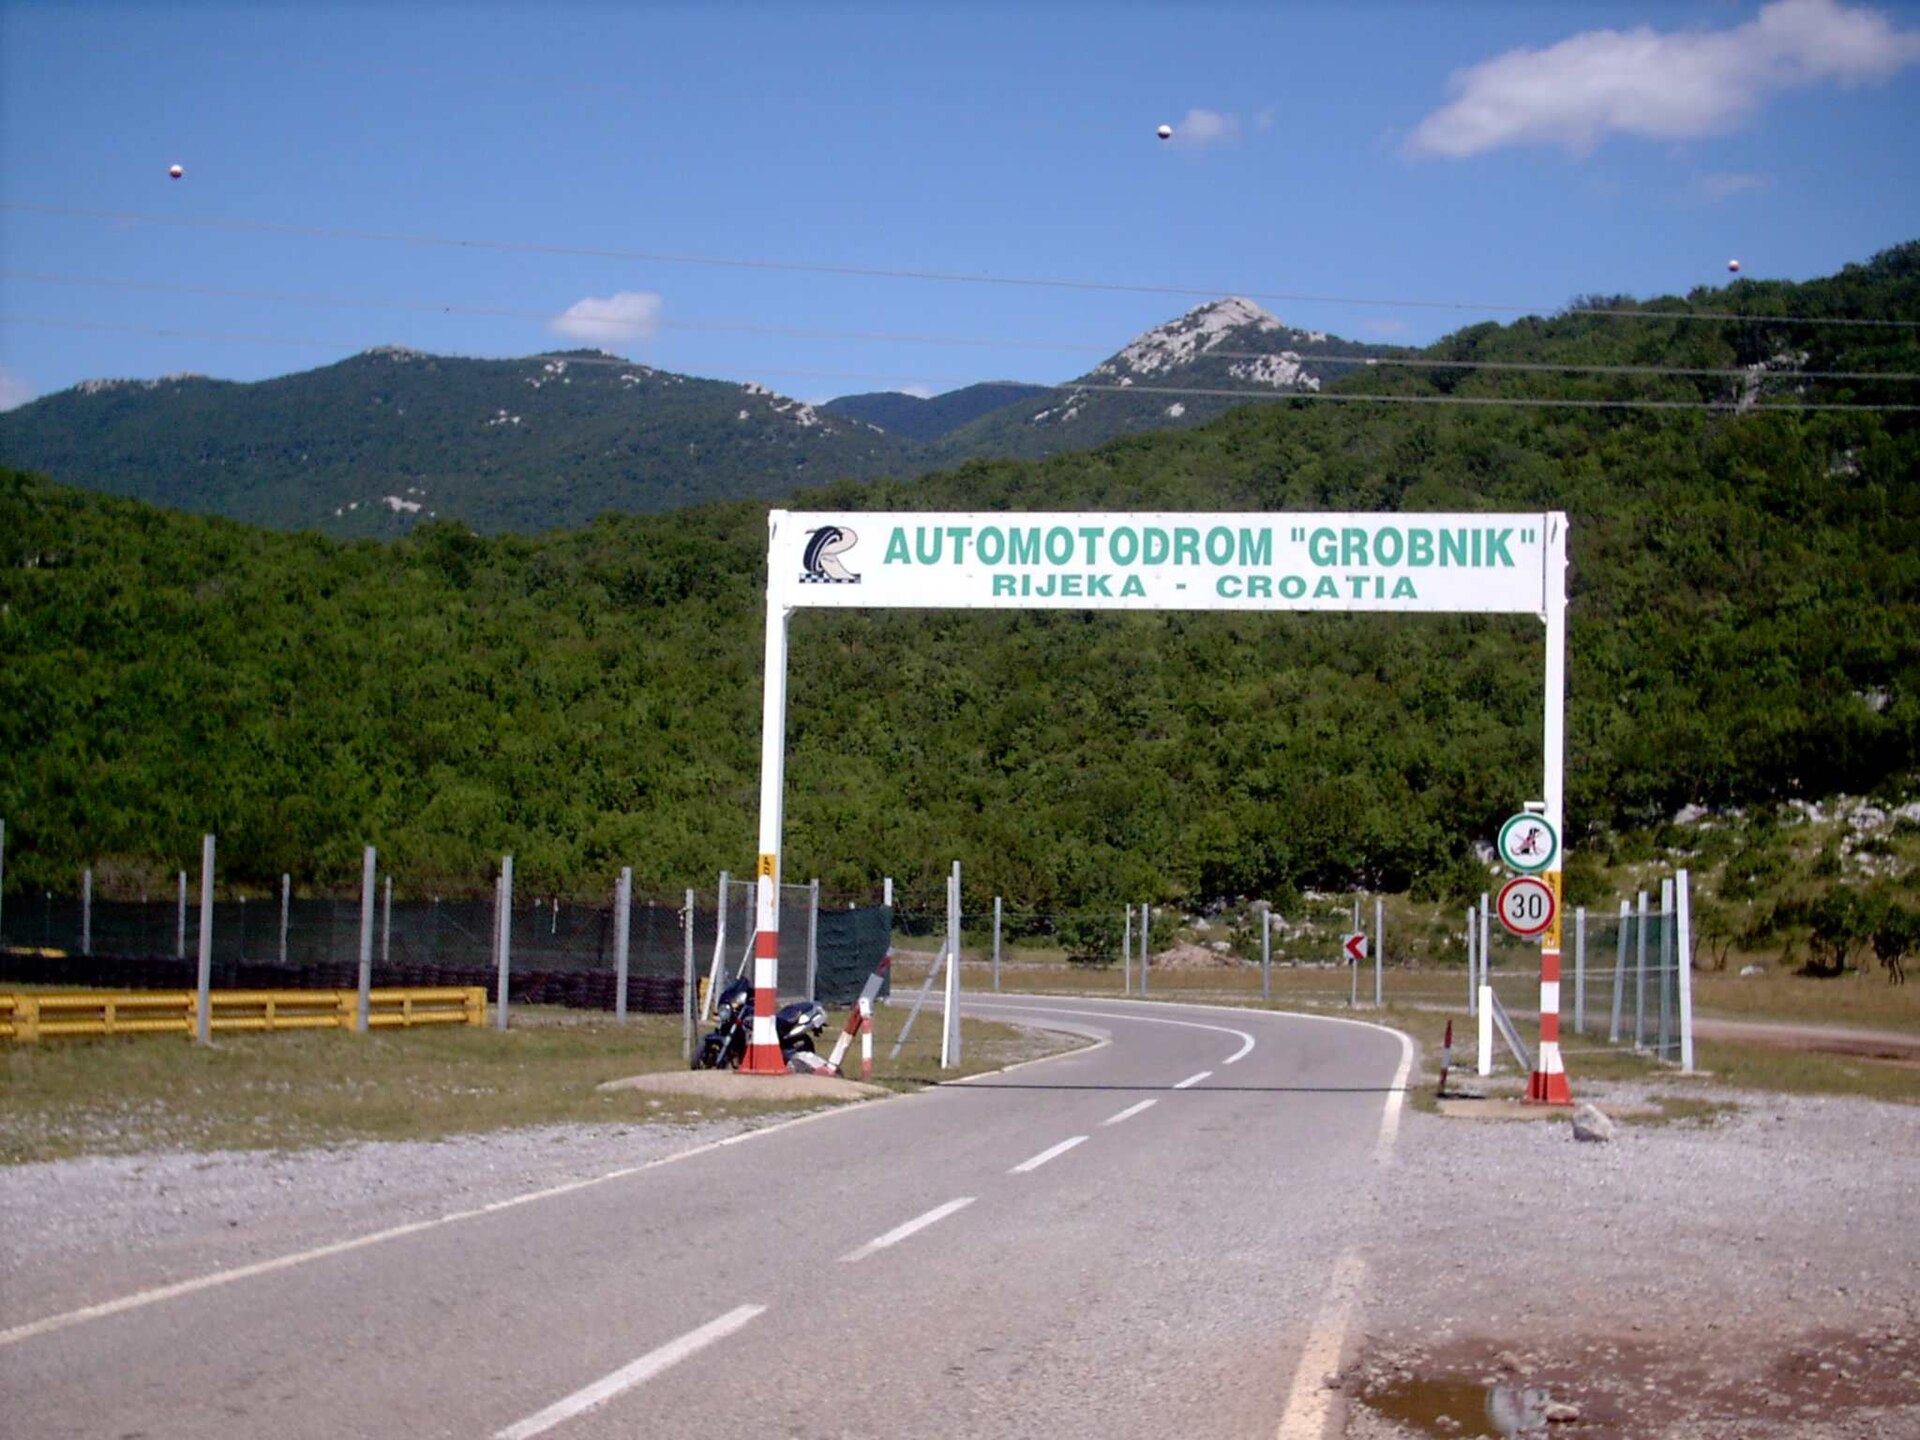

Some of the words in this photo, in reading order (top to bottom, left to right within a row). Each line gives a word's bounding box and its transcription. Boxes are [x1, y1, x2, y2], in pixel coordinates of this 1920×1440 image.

[883, 526, 1273, 567] AUTOMOTODROM
[1291, 526, 1536, 567] "GROBNIK"
[992, 573, 1147, 598] RIJEKA
[1215, 574, 1418, 600] CROATIA
[1511, 893, 1542, 919] 30
